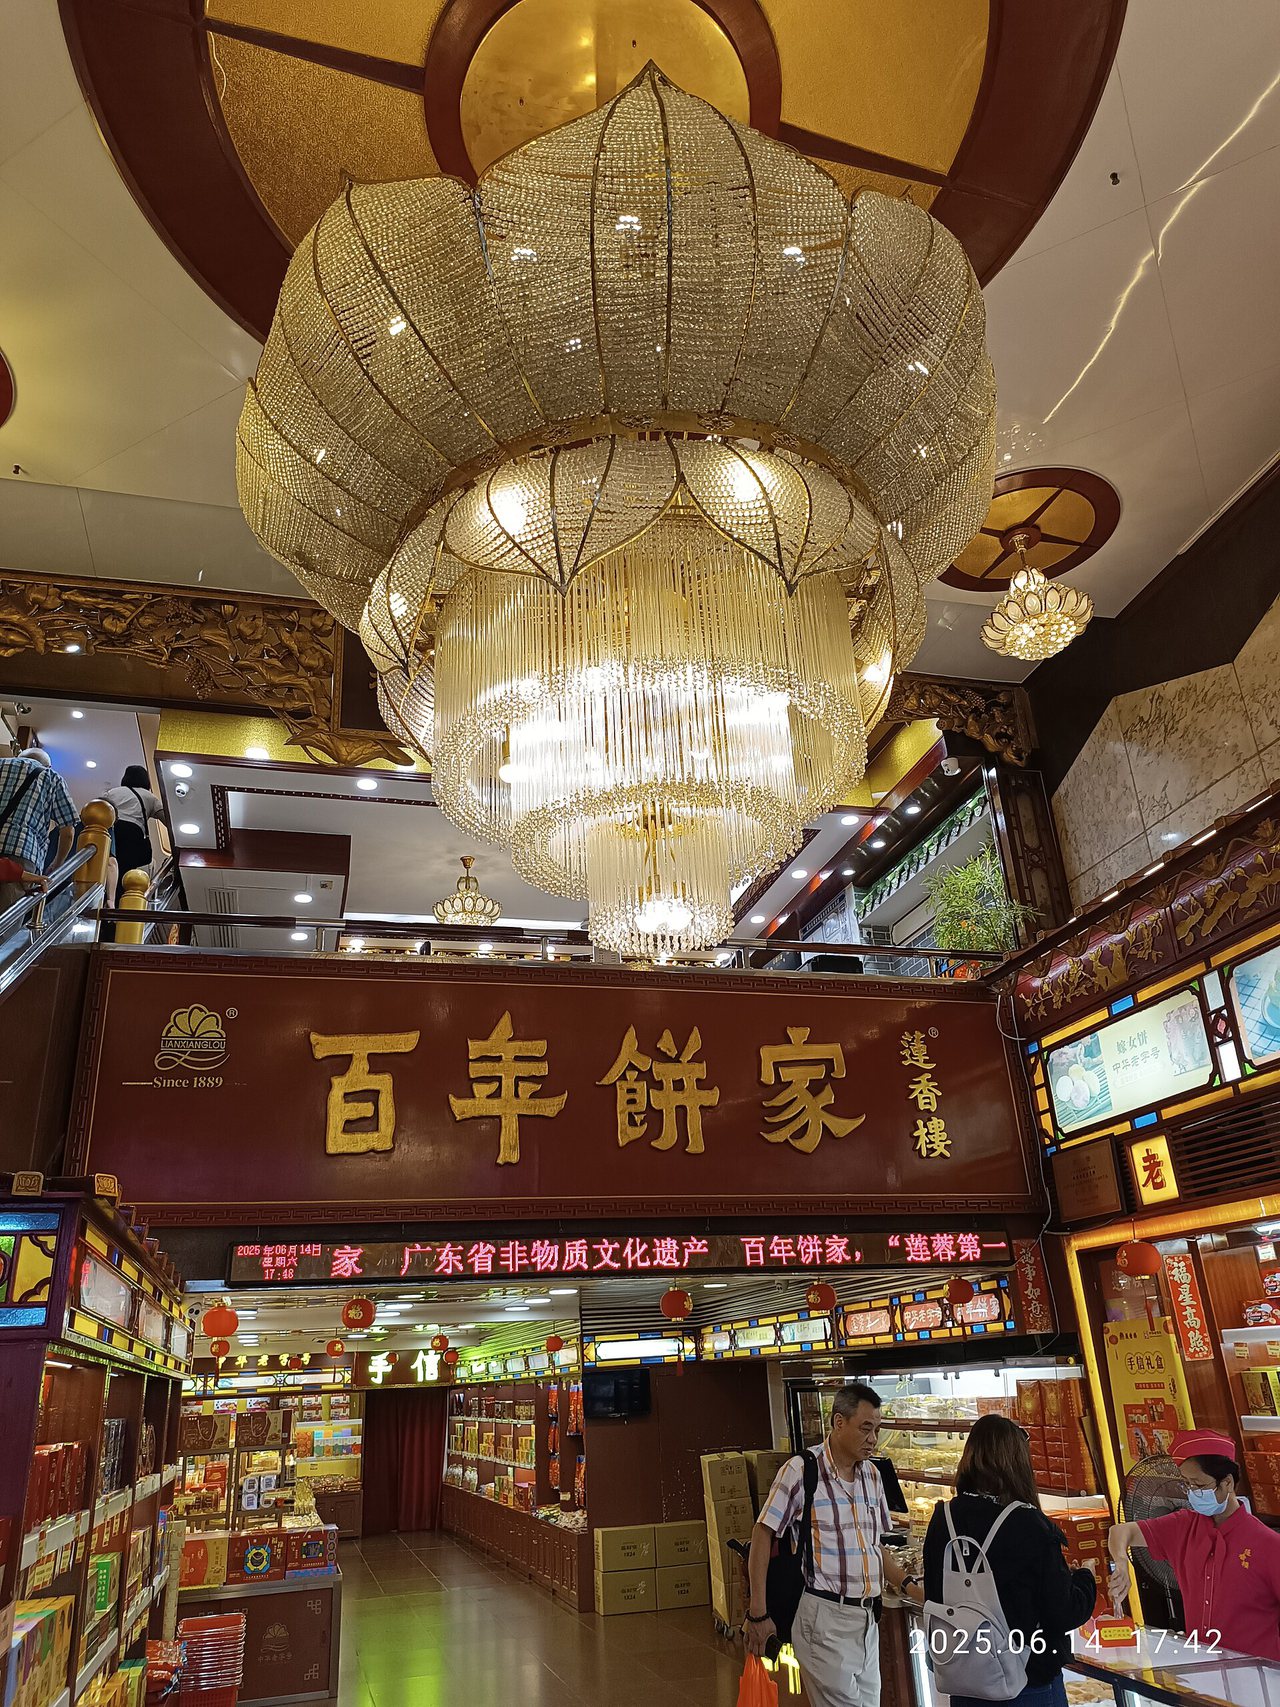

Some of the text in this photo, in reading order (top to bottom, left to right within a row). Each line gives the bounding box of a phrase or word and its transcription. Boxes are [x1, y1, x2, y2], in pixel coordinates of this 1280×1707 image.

[160, 1040, 226, 1049] LIANXIANGLOU
[153, 1076, 223, 1088] Since 1889
[900, 1030, 952, 1158] 蓮香樓
[1141, 1147, 1165, 1191] 老
[262, 1256, 298, 1267] 星期六
[331, 1245, 363, 1277] 家
[400, 1235, 709, 1276] 广东省非物质文化遗产
[264, 1268, 294, 1280] 17:48
[368, 1350, 440, 1384] 手信
